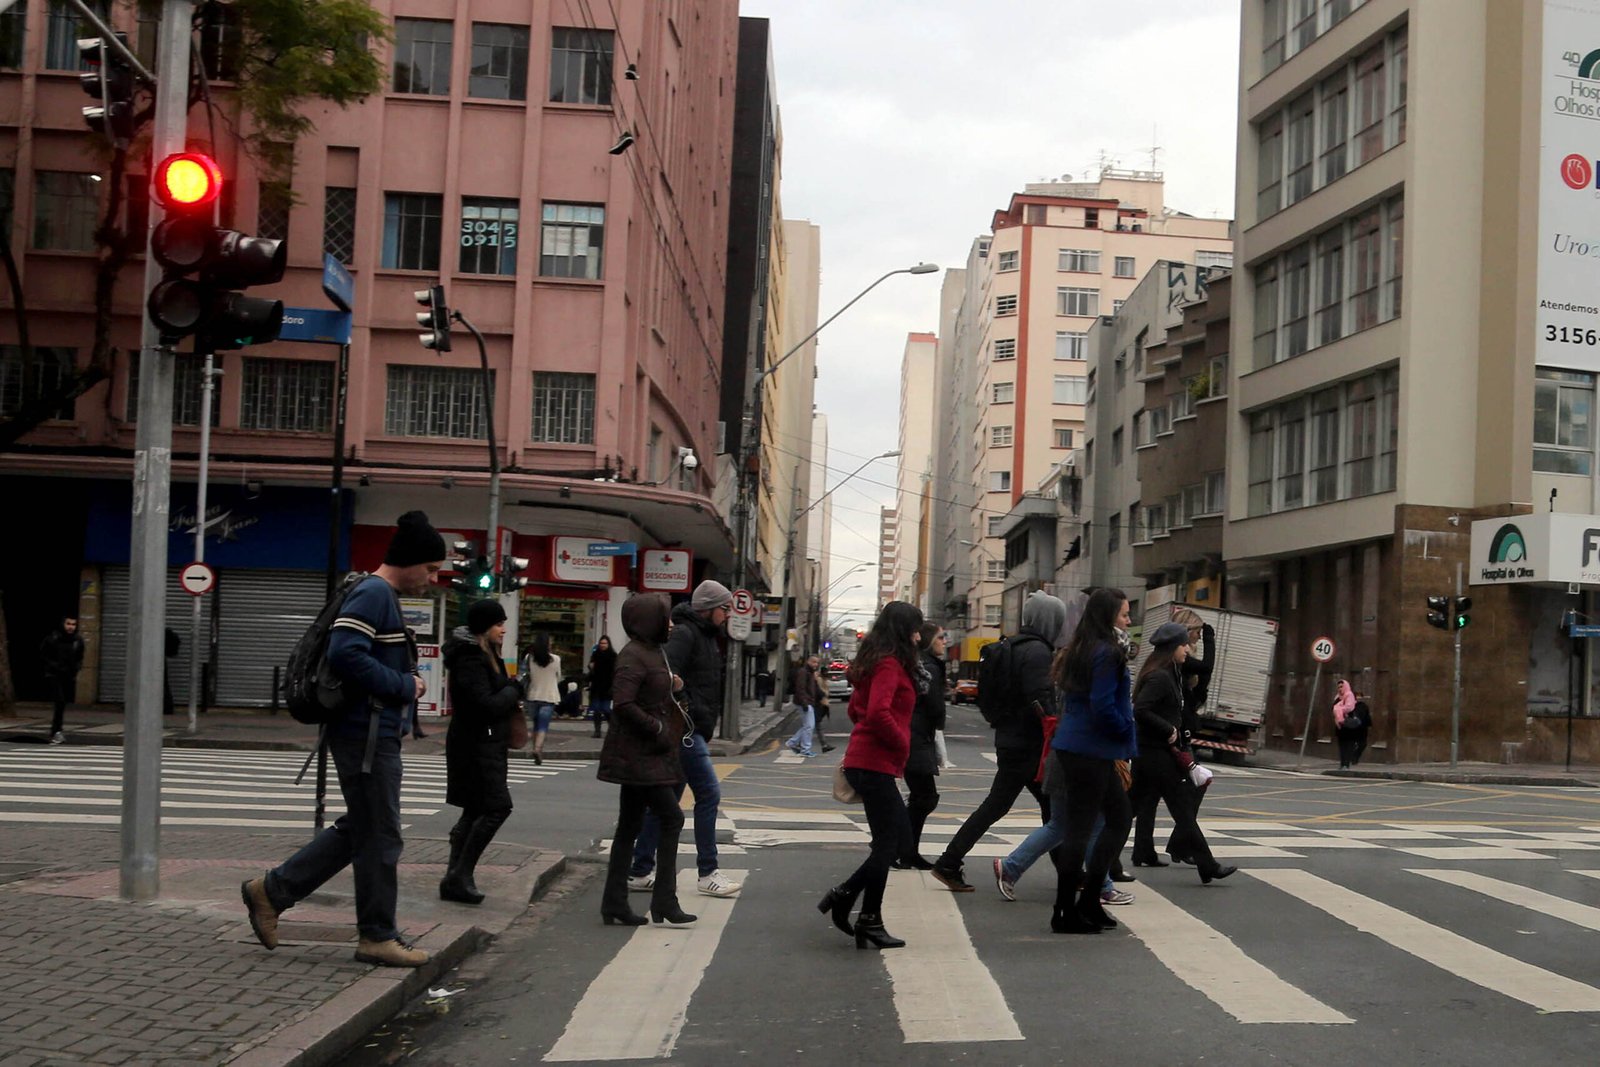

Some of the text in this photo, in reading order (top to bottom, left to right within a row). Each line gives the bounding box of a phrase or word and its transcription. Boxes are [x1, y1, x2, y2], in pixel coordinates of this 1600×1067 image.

[1555, 96, 1595, 116] Olhos
[461, 221, 517, 236] 3045
[461, 234, 517, 249] 0915
[1554, 234, 1600, 258] Uroc
[1540, 300, 1599, 315] Atendemos
[572, 557, 609, 568] DESCONTÃO
[645, 571, 687, 582] DESCONTÃO
[1482, 567, 1535, 581] Hospital de Olhos
[418, 646, 434, 657] QUI
[1315, 642, 1331, 655] 40
